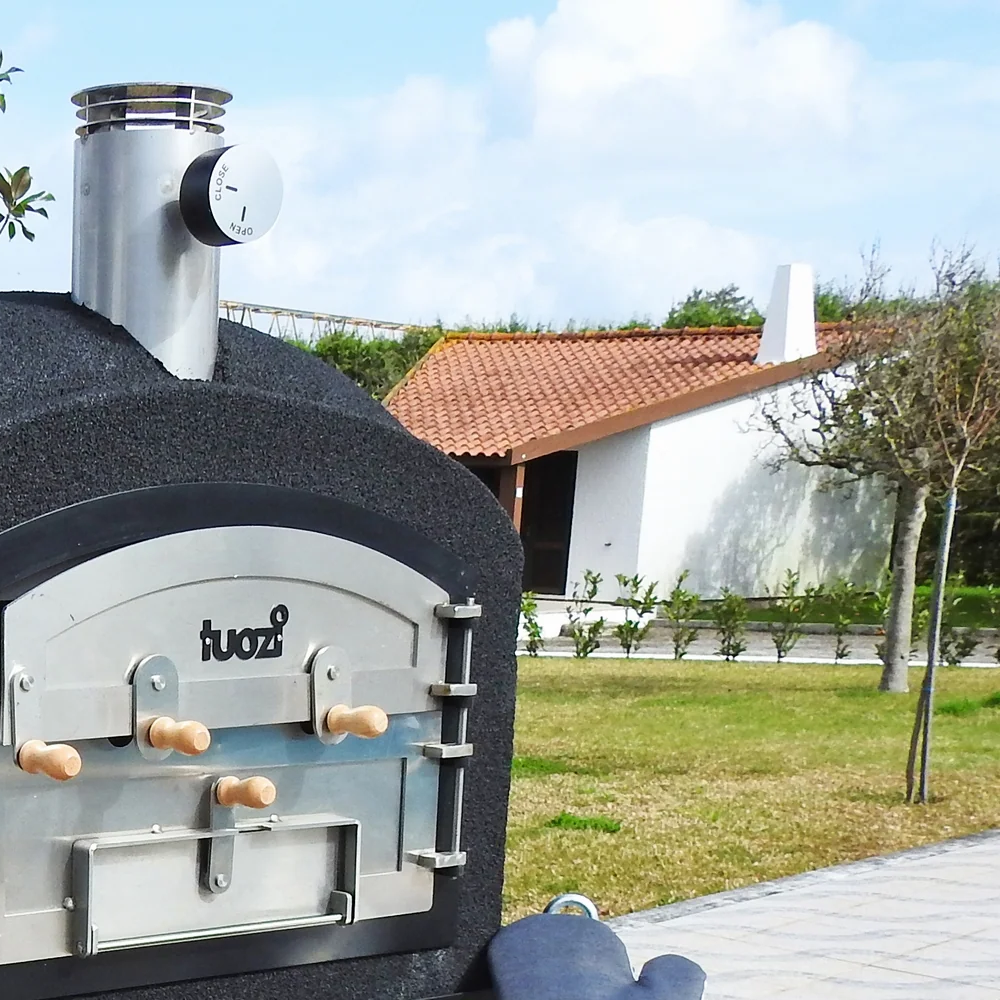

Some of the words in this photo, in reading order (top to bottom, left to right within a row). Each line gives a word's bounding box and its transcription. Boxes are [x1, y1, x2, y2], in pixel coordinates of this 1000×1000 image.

[215, 163, 229, 200] CLOSE
[230, 222, 253, 236] OPEN
[200, 604, 289, 661] tuozi
